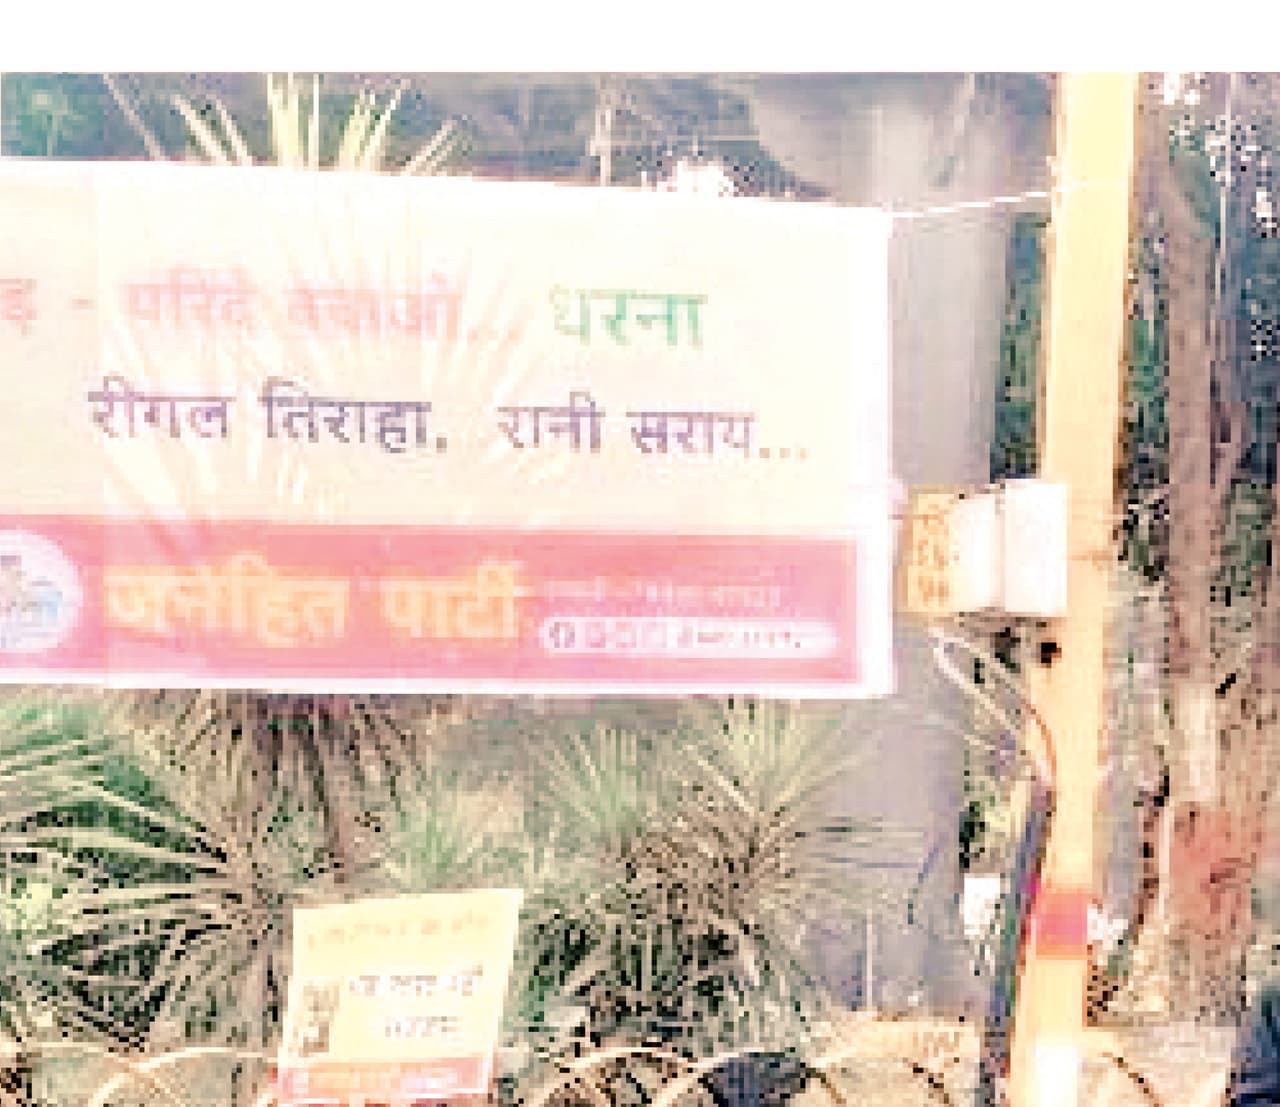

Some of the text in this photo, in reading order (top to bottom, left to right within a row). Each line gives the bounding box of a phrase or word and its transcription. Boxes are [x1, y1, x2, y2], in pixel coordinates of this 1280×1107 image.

[548, 284, 708, 350] धरना
[87, 373, 236, 438] रीगल
[497, 391, 606, 454] रानी
[104, 550, 350, 649] जनहित
